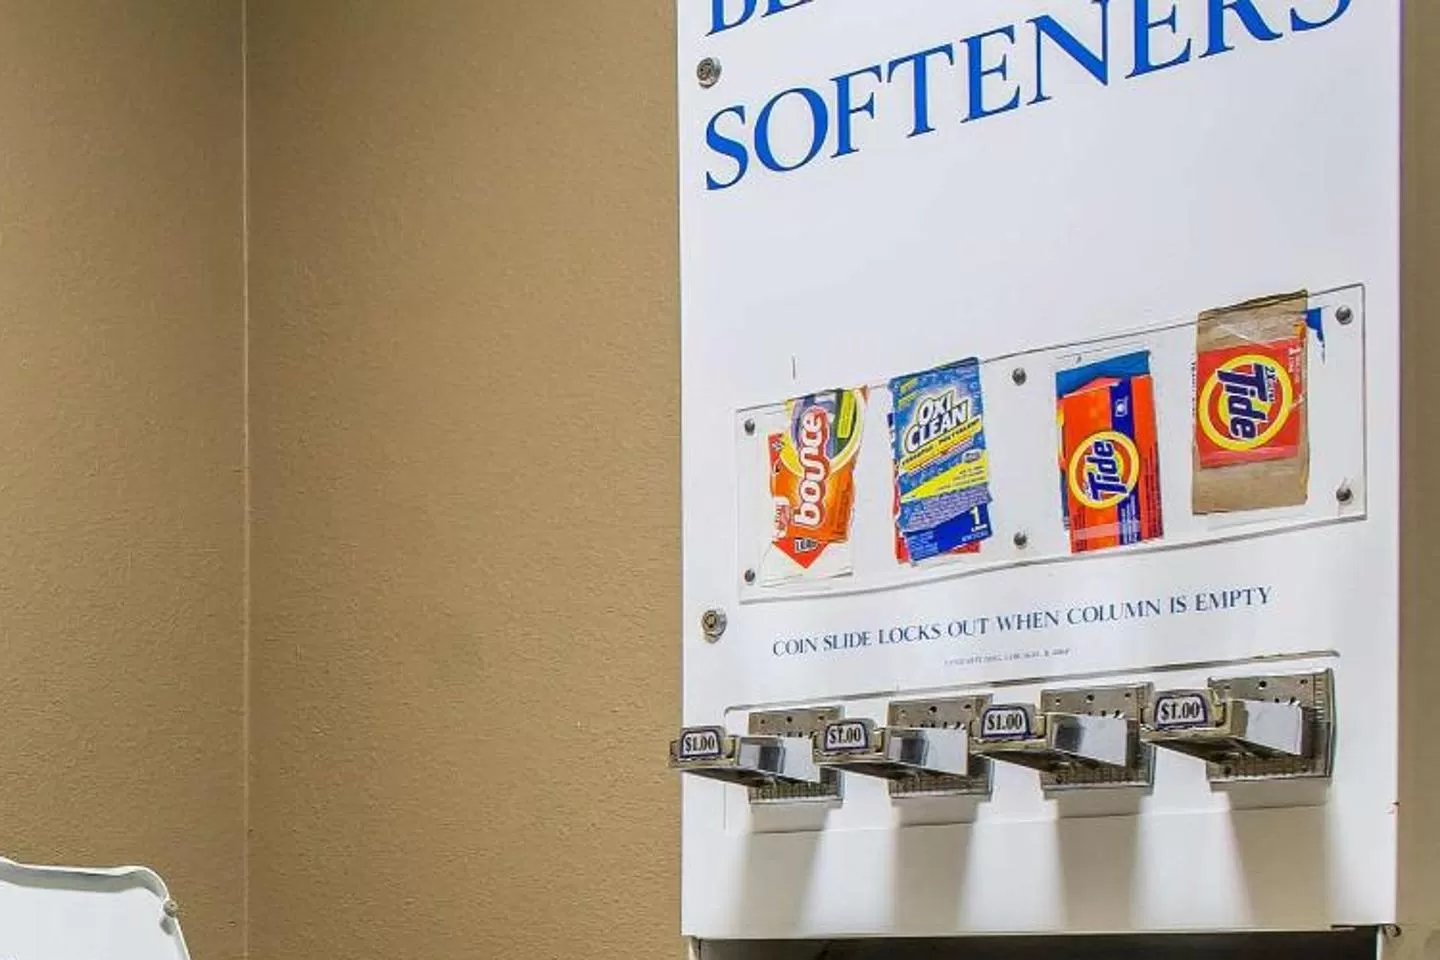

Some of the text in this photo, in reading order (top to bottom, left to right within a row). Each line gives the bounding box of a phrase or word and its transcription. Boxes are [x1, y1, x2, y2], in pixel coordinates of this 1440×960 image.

[918, 390, 954, 425] OXI
[1216, 362, 1268, 440] Tide
[905, 402, 968, 452] CLEAN
[794, 408, 828, 528] bounce
[1086, 439, 1129, 501] Tide
[772, 585, 1273, 657] COIN SLIDE LOCKS OUT WHEN COLUMN IS EMPTY
[987, 713, 1023, 731] $1.00
[1160, 701, 1201, 720] $1.00
[684, 736, 716, 754] $1.00
[828, 726, 862, 746] $1.00
